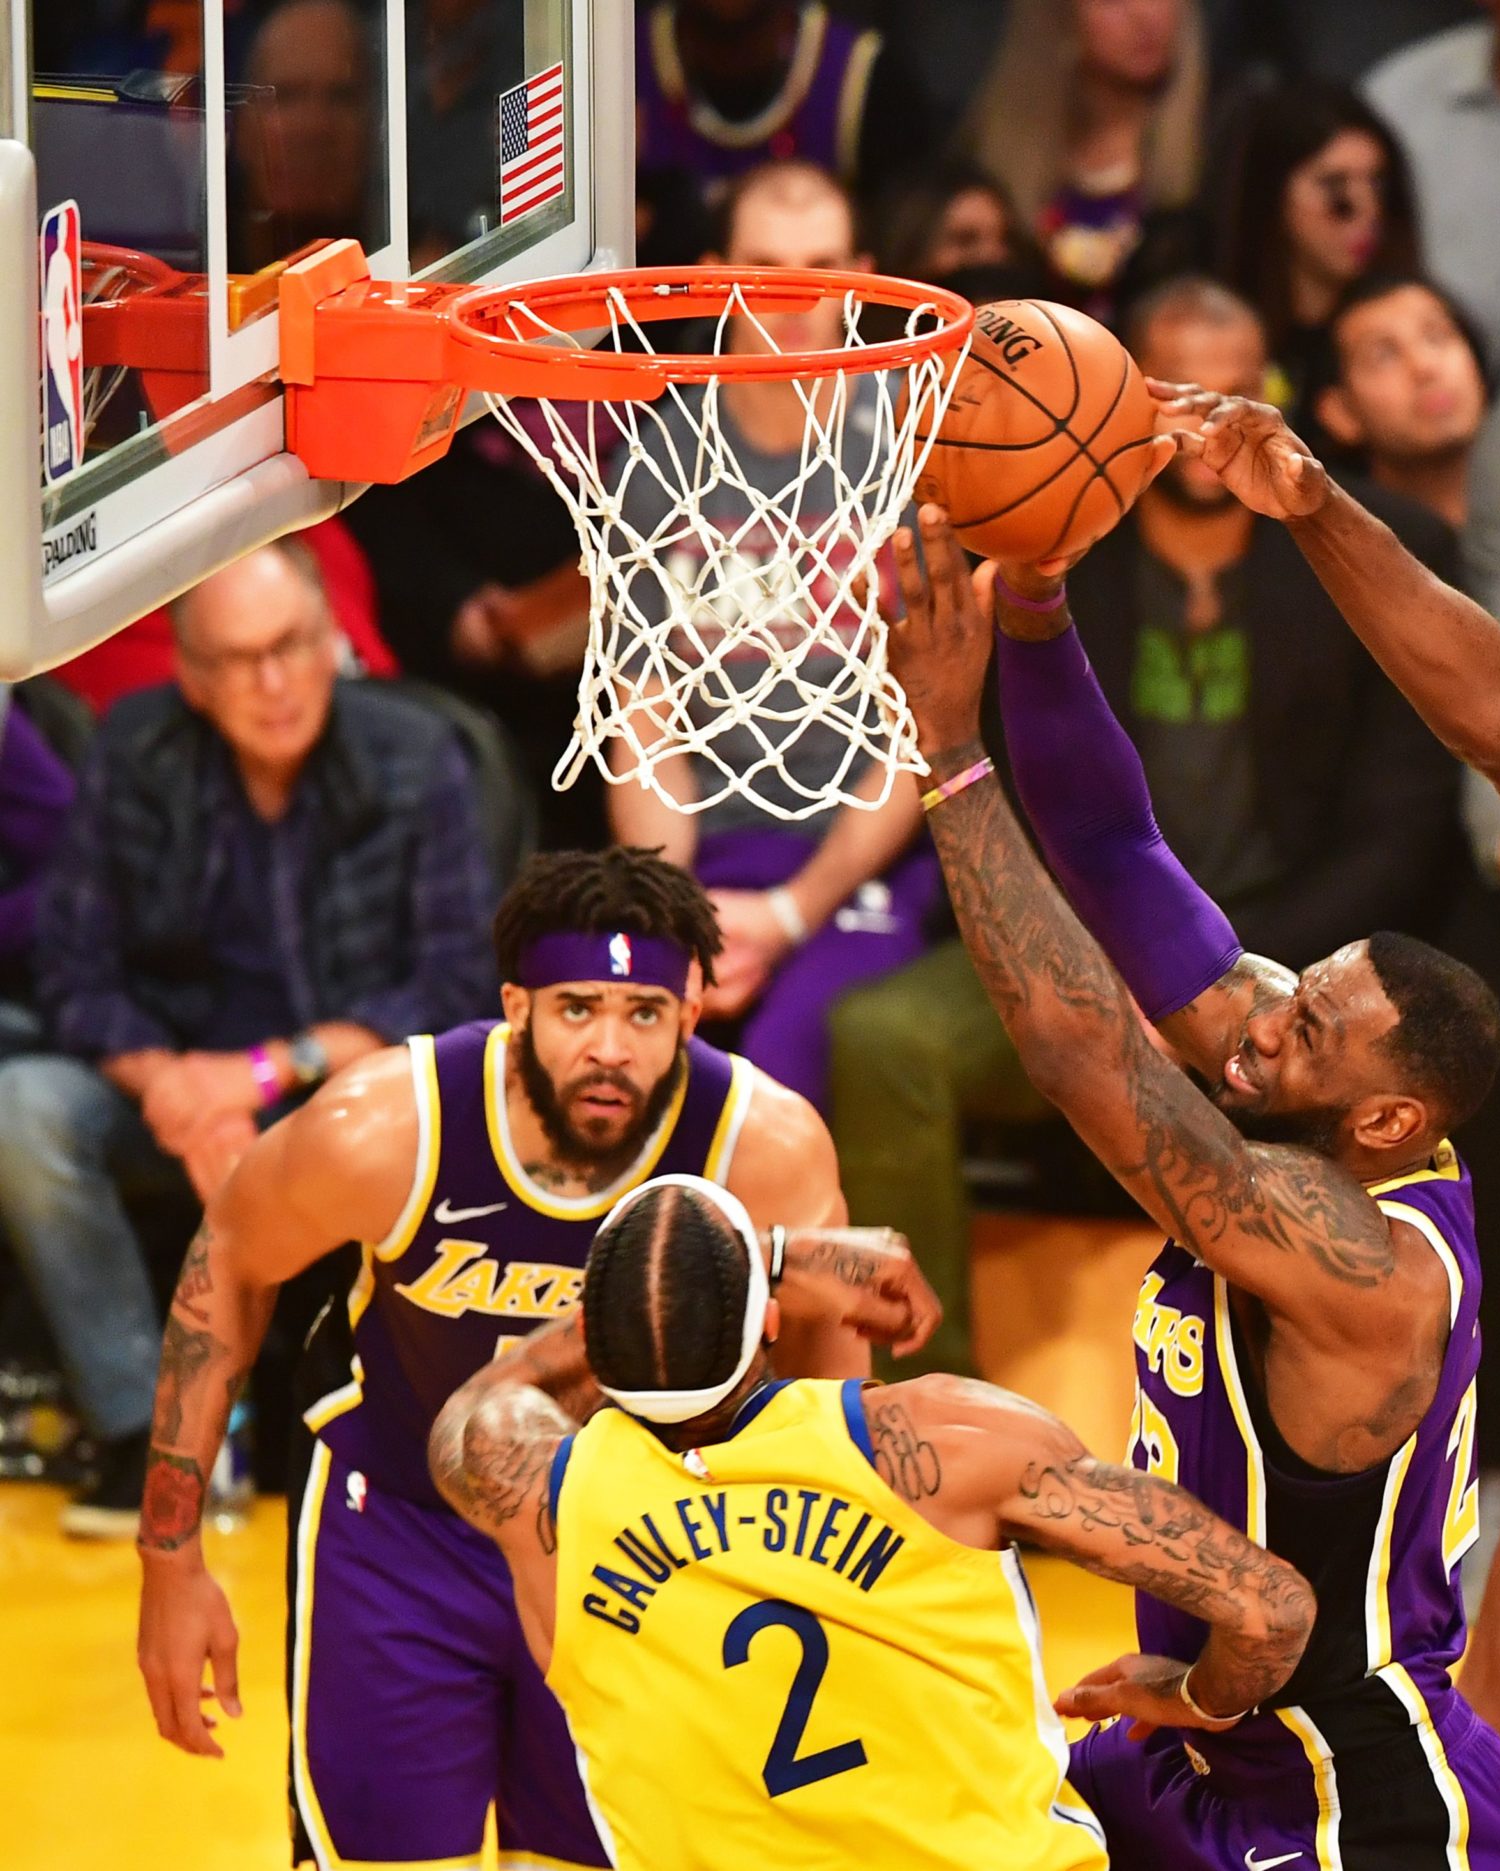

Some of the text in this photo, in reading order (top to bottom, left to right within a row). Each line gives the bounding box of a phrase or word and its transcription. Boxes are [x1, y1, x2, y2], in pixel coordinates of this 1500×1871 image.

[42, 511, 97, 576] PALDING
[394, 1238, 588, 1319] LAKE
[1441, 1373, 1481, 1586] 2
[583, 1488, 905, 1634] CAULEY-STEIN
[722, 1597, 868, 1798] 2
